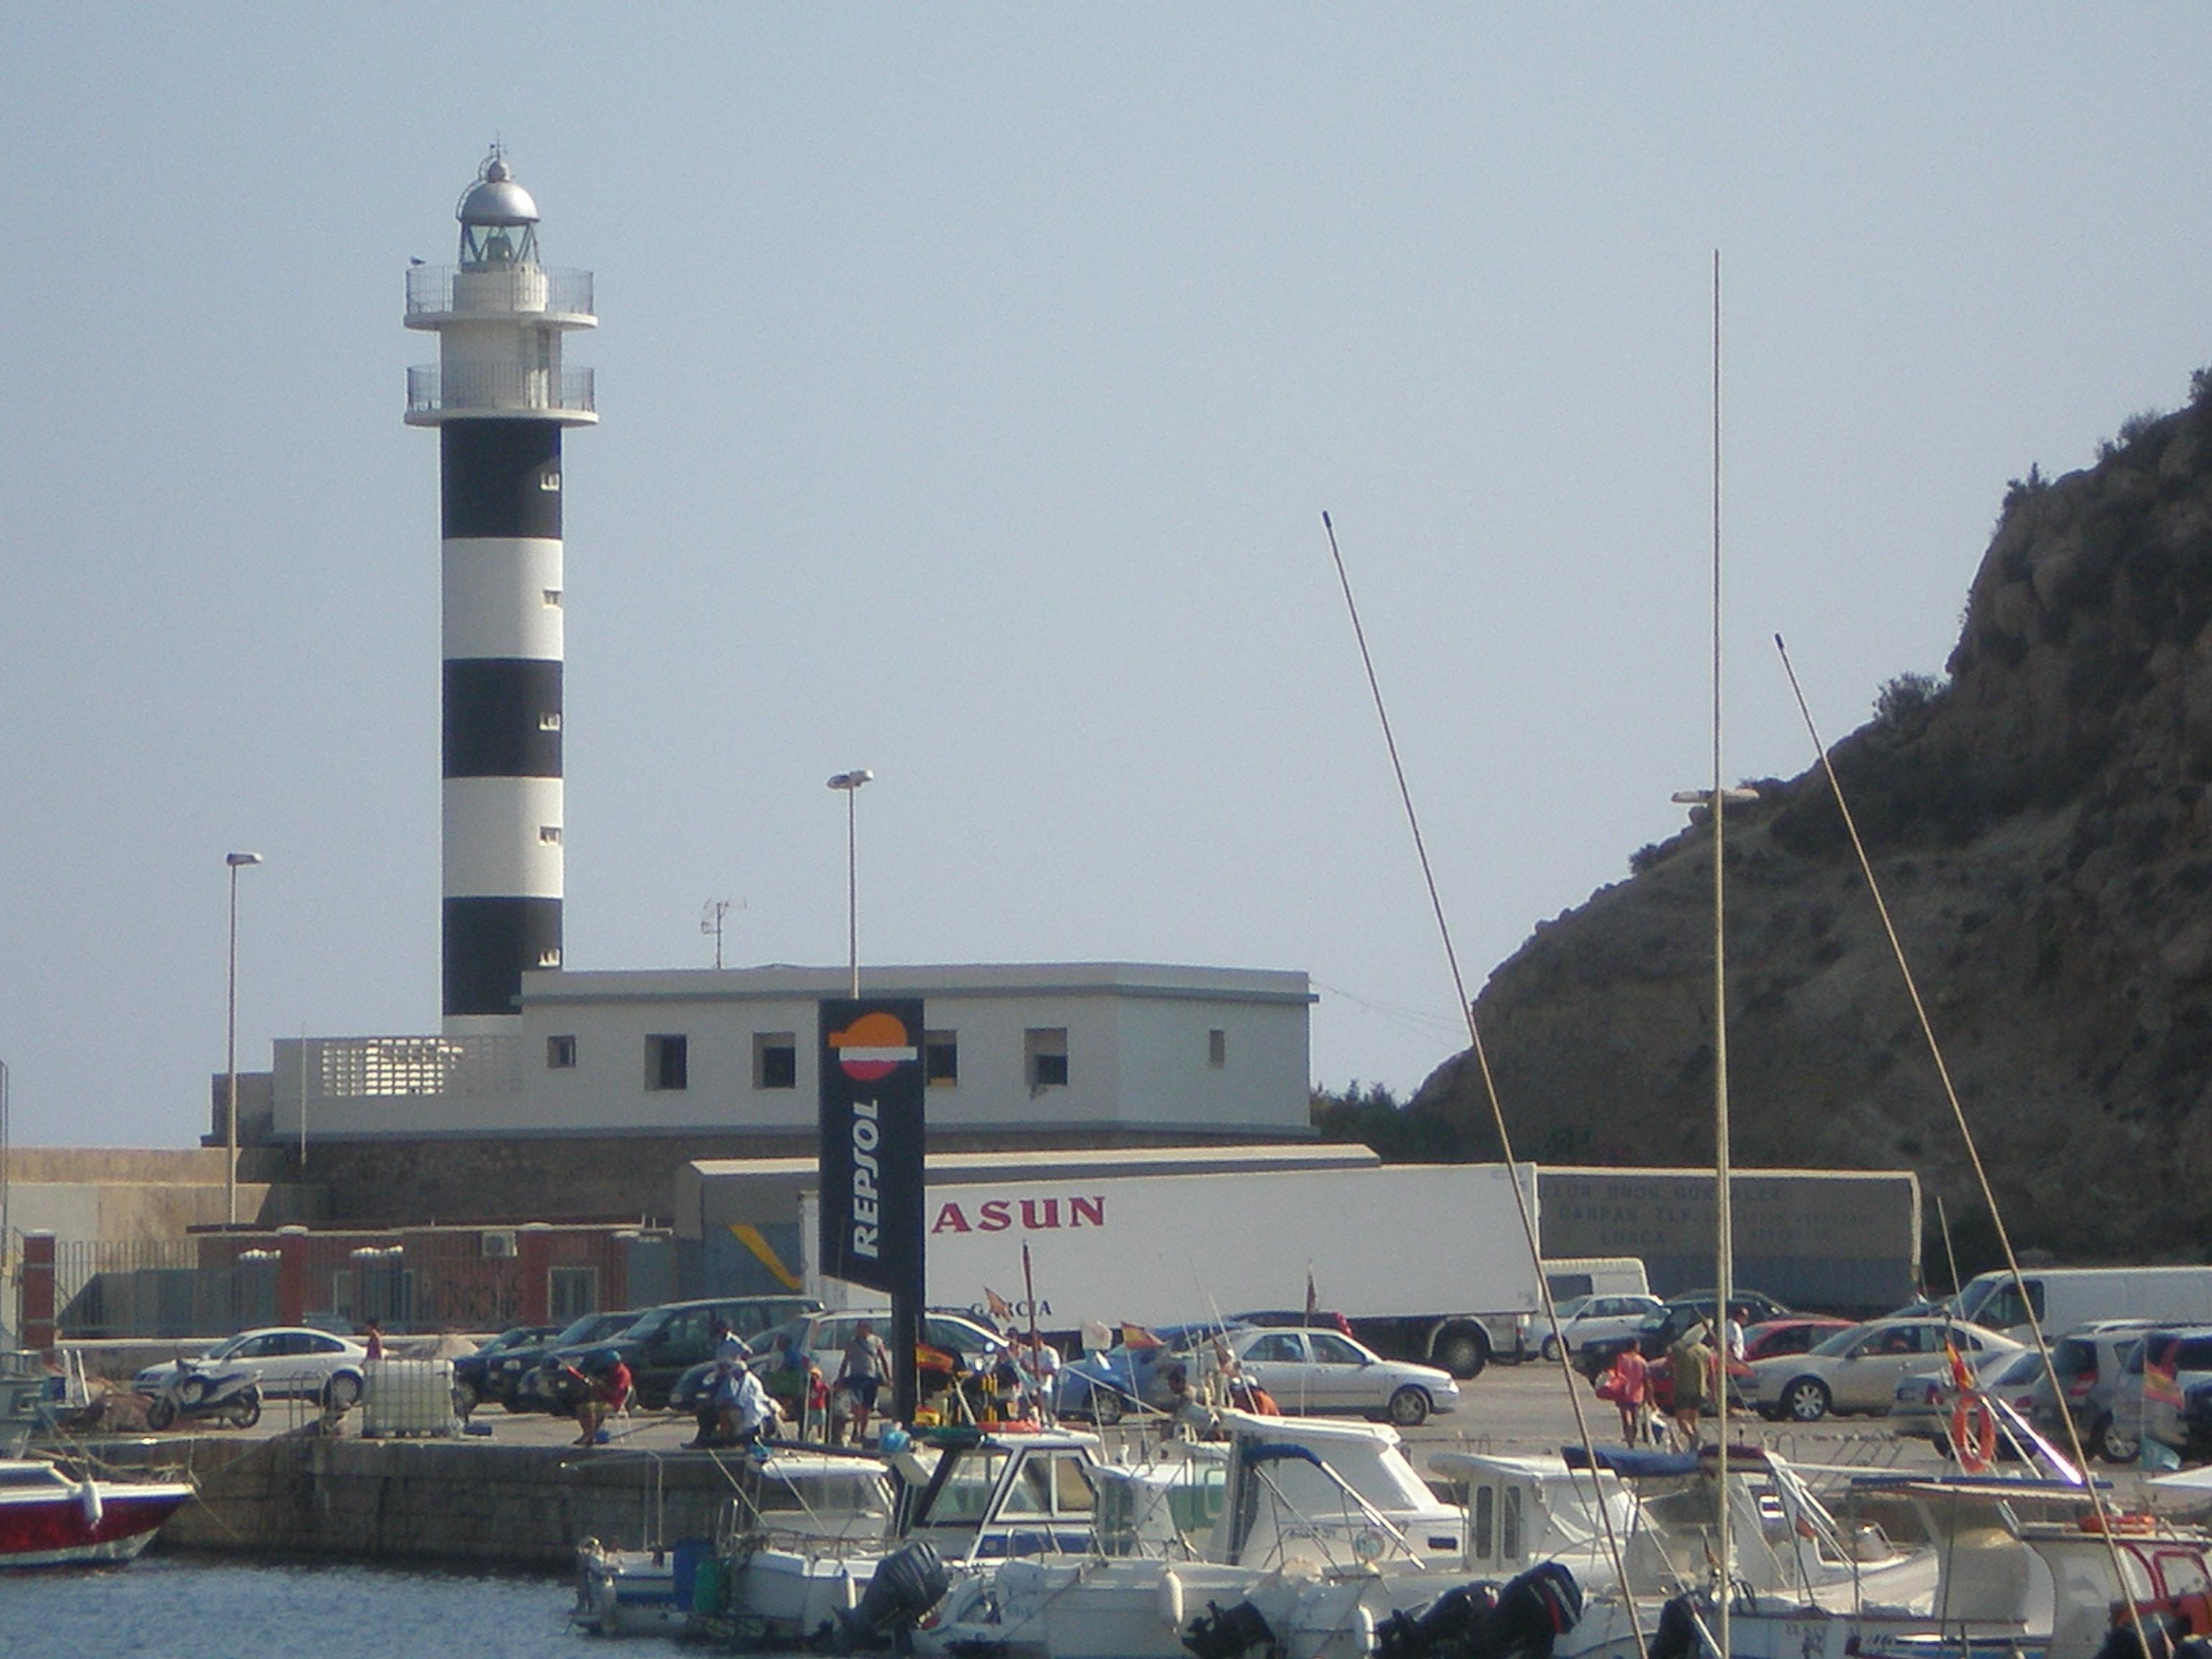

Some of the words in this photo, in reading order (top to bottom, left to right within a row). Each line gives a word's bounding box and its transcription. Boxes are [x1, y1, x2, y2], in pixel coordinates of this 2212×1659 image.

[853, 1099, 879, 1258] REPSOL
[1673, 1185, 1781, 1201] GONALEZ
[931, 1196, 1106, 1233] ASUN
